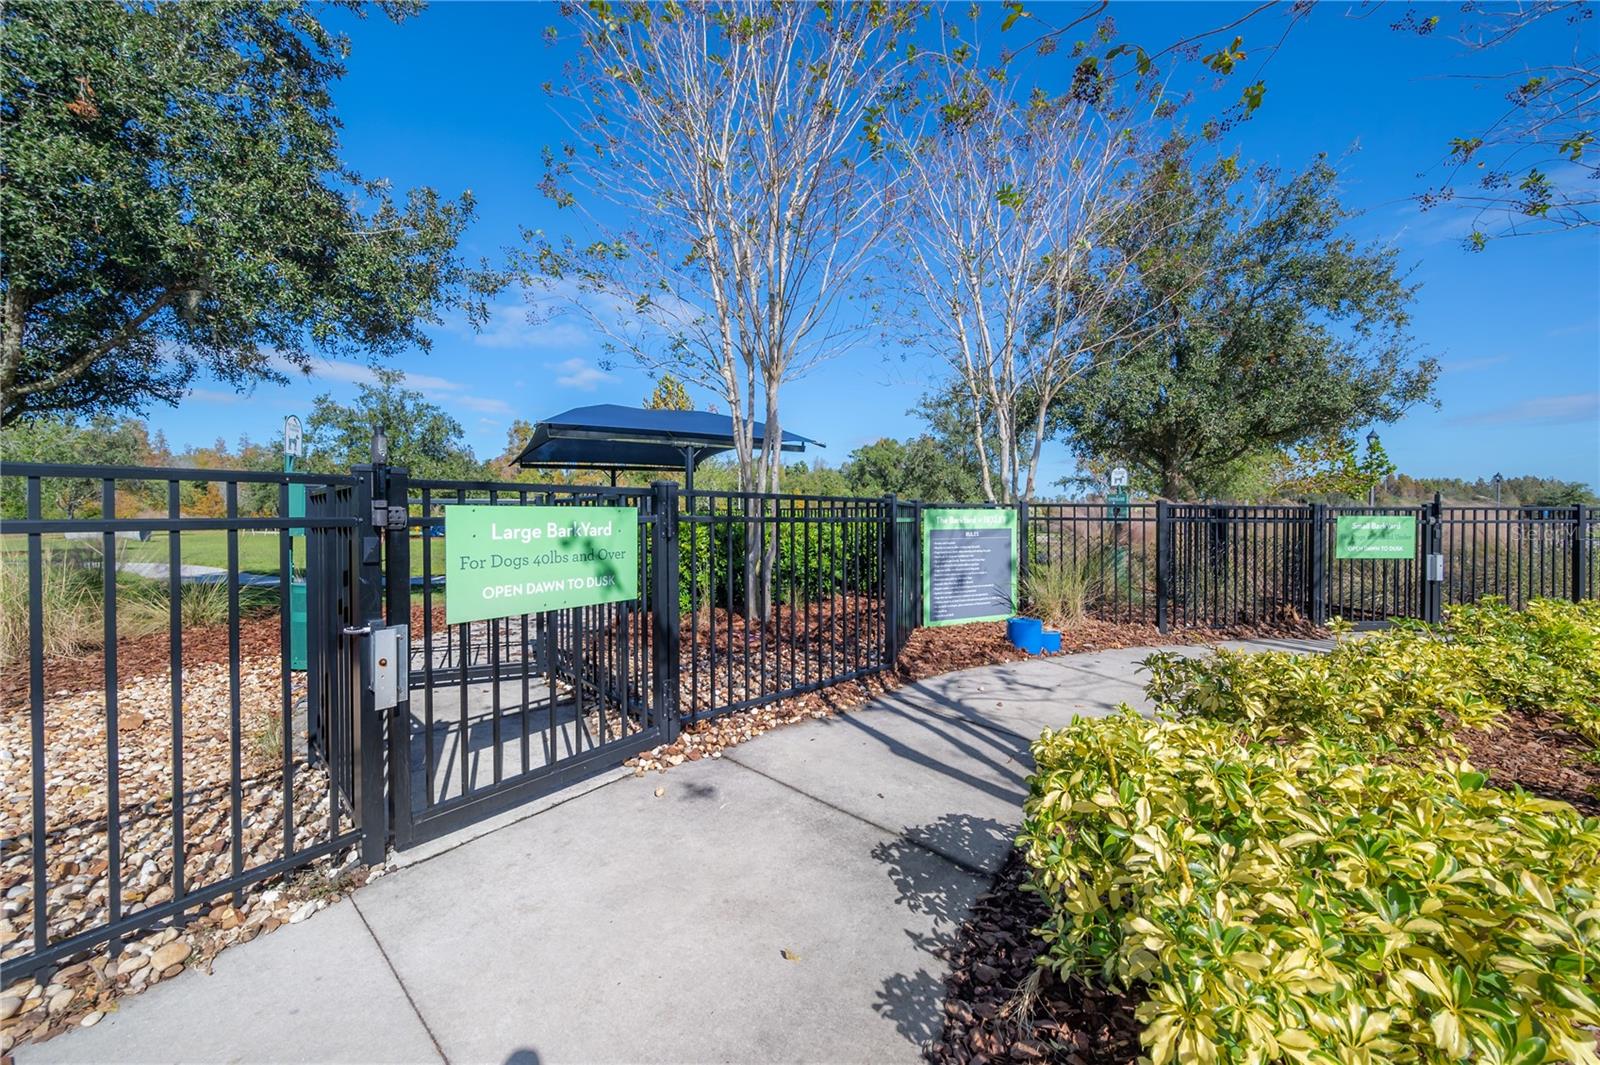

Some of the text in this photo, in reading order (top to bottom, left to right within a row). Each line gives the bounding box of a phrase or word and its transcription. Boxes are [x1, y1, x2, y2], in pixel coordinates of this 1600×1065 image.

[492, 521, 612, 544] Large BarkYard
[460, 548, 626, 570] For Dogs 40lbs and Over
[482, 575, 616, 600] OPEN DAWN TO DUSK
